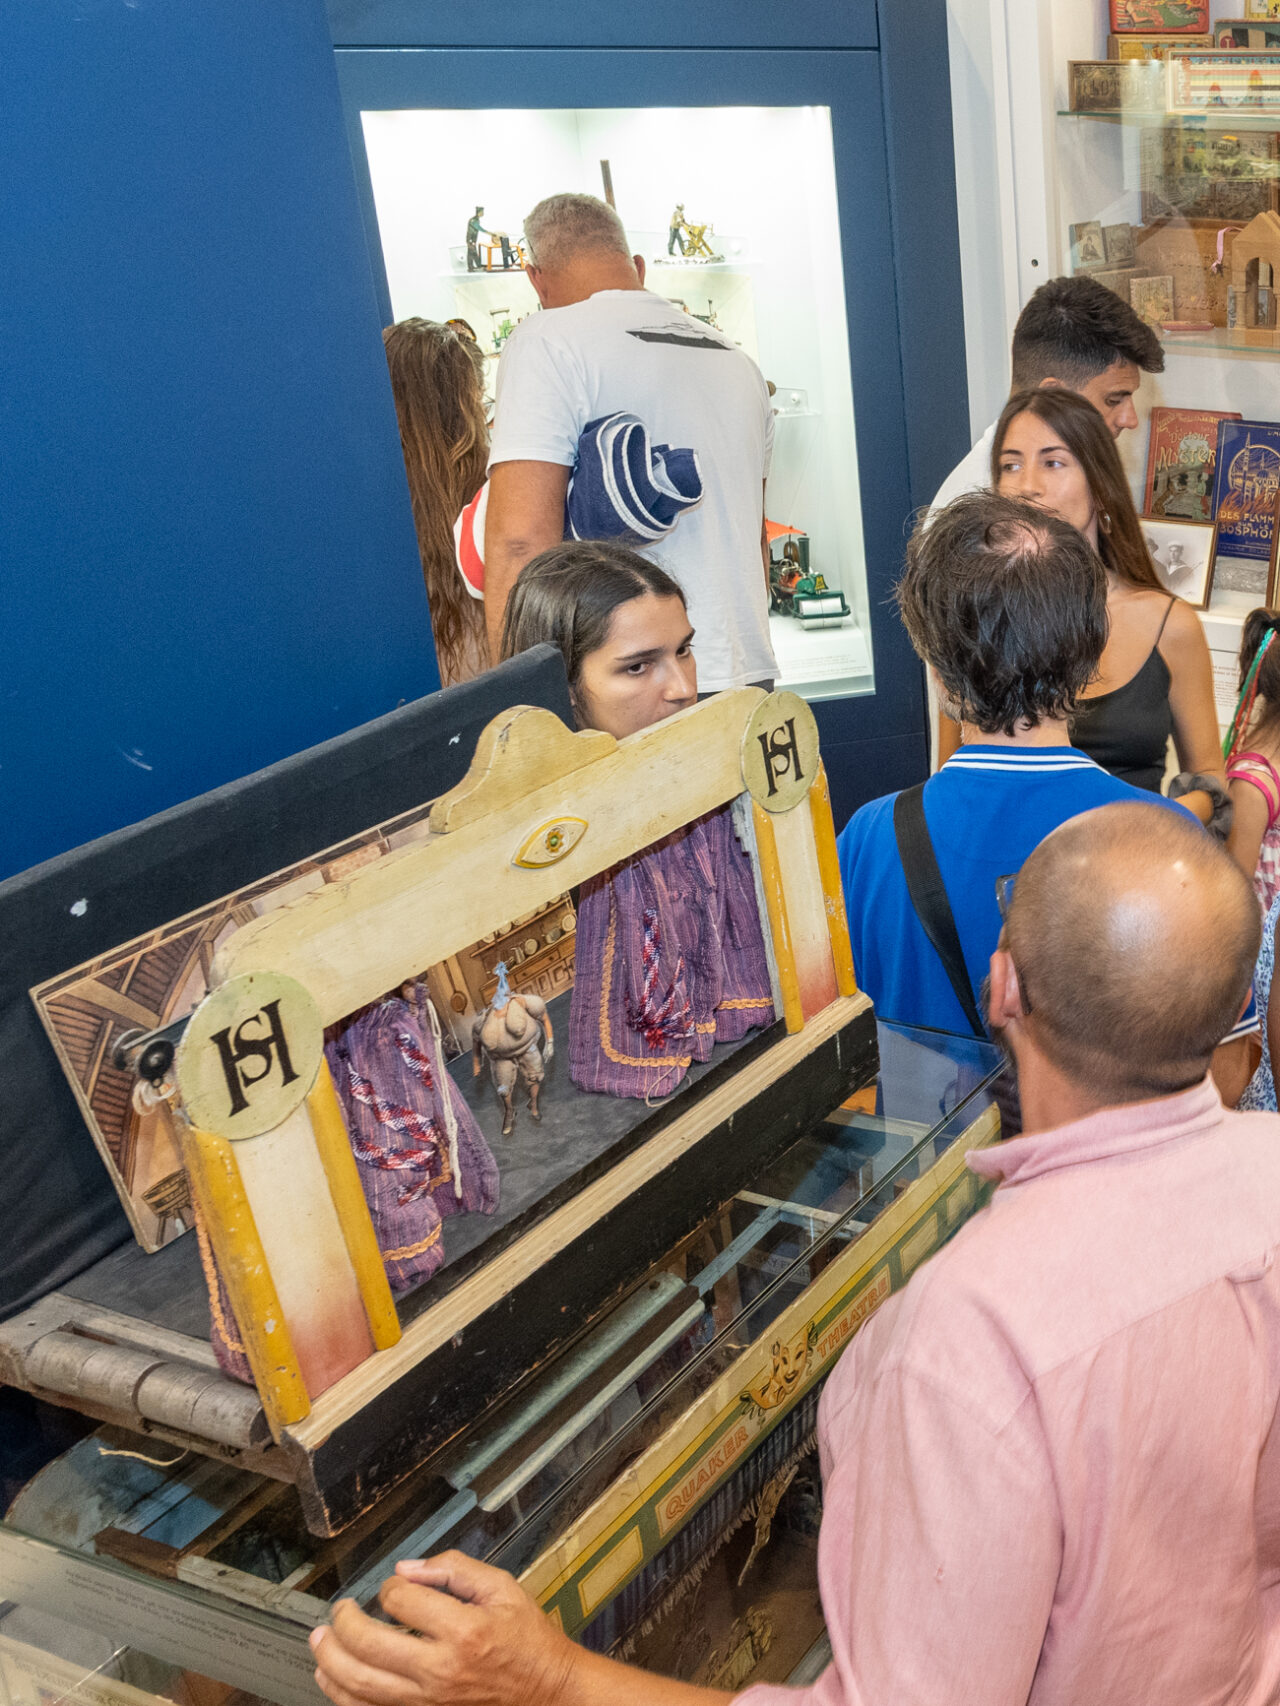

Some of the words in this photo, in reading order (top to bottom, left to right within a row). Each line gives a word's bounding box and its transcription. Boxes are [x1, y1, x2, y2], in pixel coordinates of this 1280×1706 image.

[1156, 445, 1217, 472] MYSTER
[1219, 509, 1240, 520] DES
[1243, 512, 1276, 525] FLAMM
[664, 1427, 749, 1522] QUAKER
[815, 1276, 889, 1359] THEATRE
